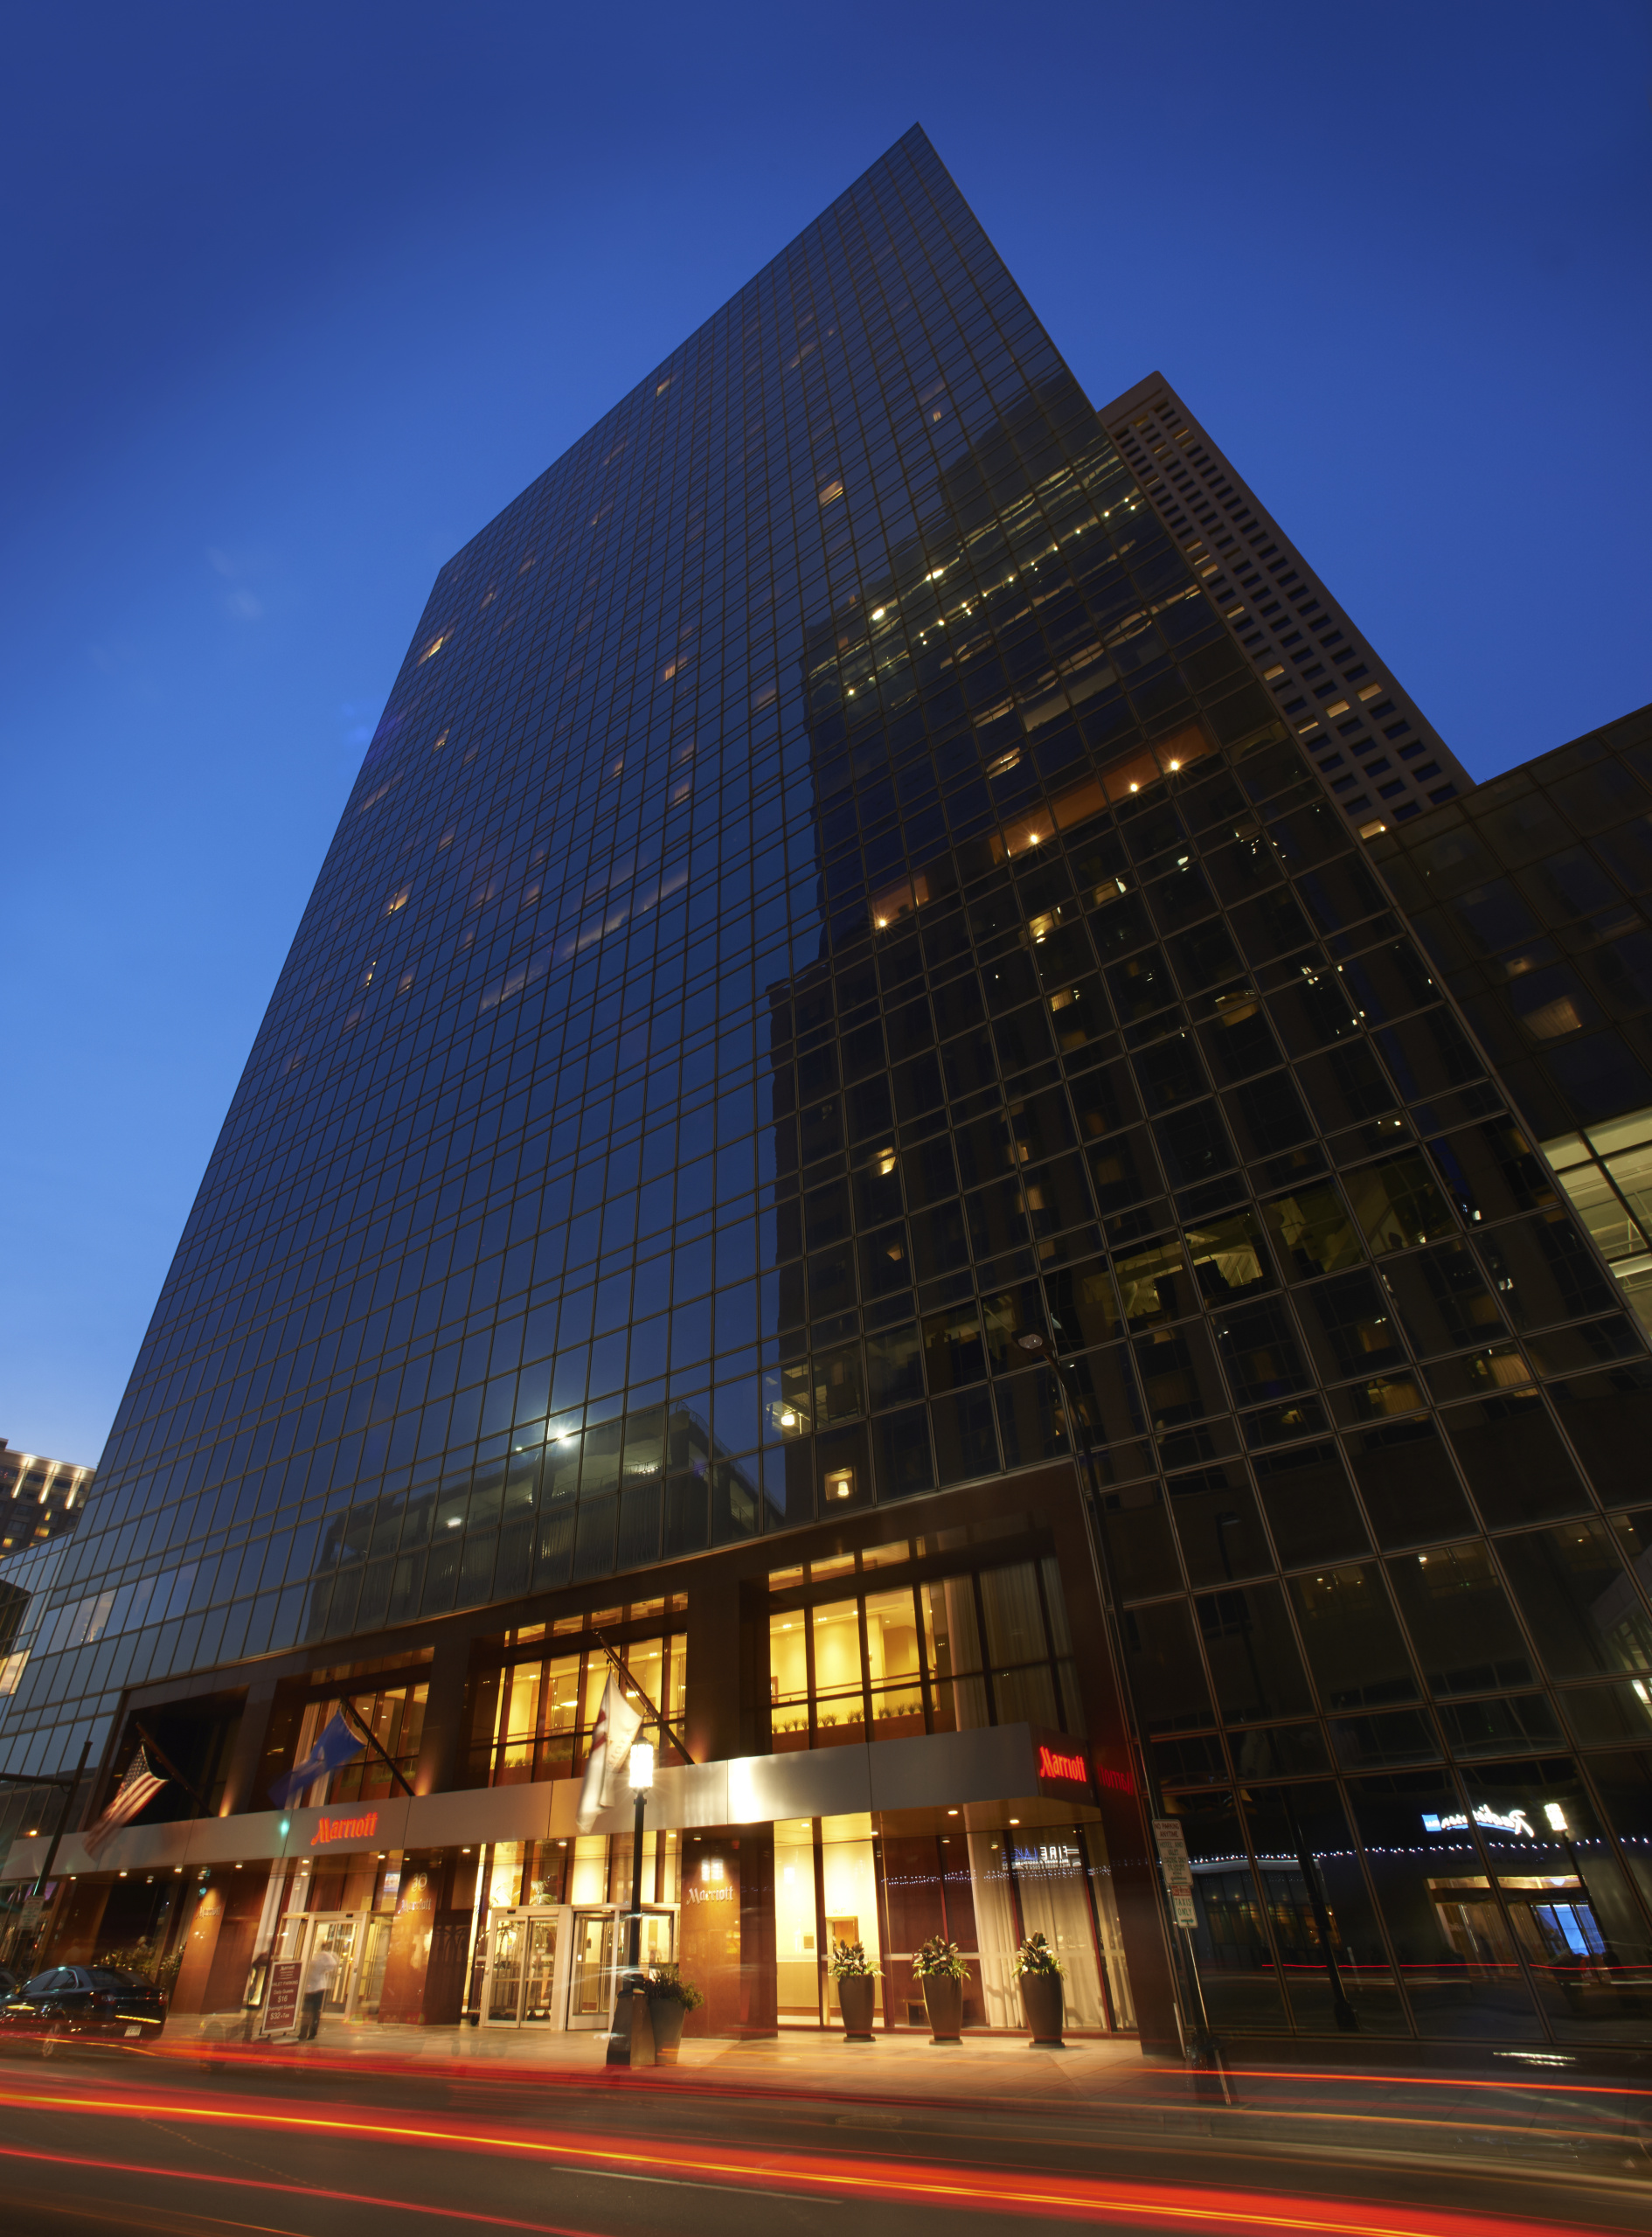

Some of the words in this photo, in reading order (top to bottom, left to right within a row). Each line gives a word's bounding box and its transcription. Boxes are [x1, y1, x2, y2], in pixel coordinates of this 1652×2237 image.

[1039, 1746, 1086, 1782] Marriott
[310, 1811, 378, 1845] Marriott
[413, 1872, 428, 1890] 30
[686, 1886, 734, 1905] Marriott
[1175, 1898, 1192, 1907] TAXIS
[195, 1905, 222, 1920] Marriott
[398, 1898, 432, 1914] Marriott
[1177, 1907, 1192, 1916] ONLY
[277, 1995, 288, 2004] $16
[270, 2011, 281, 2020] $32
